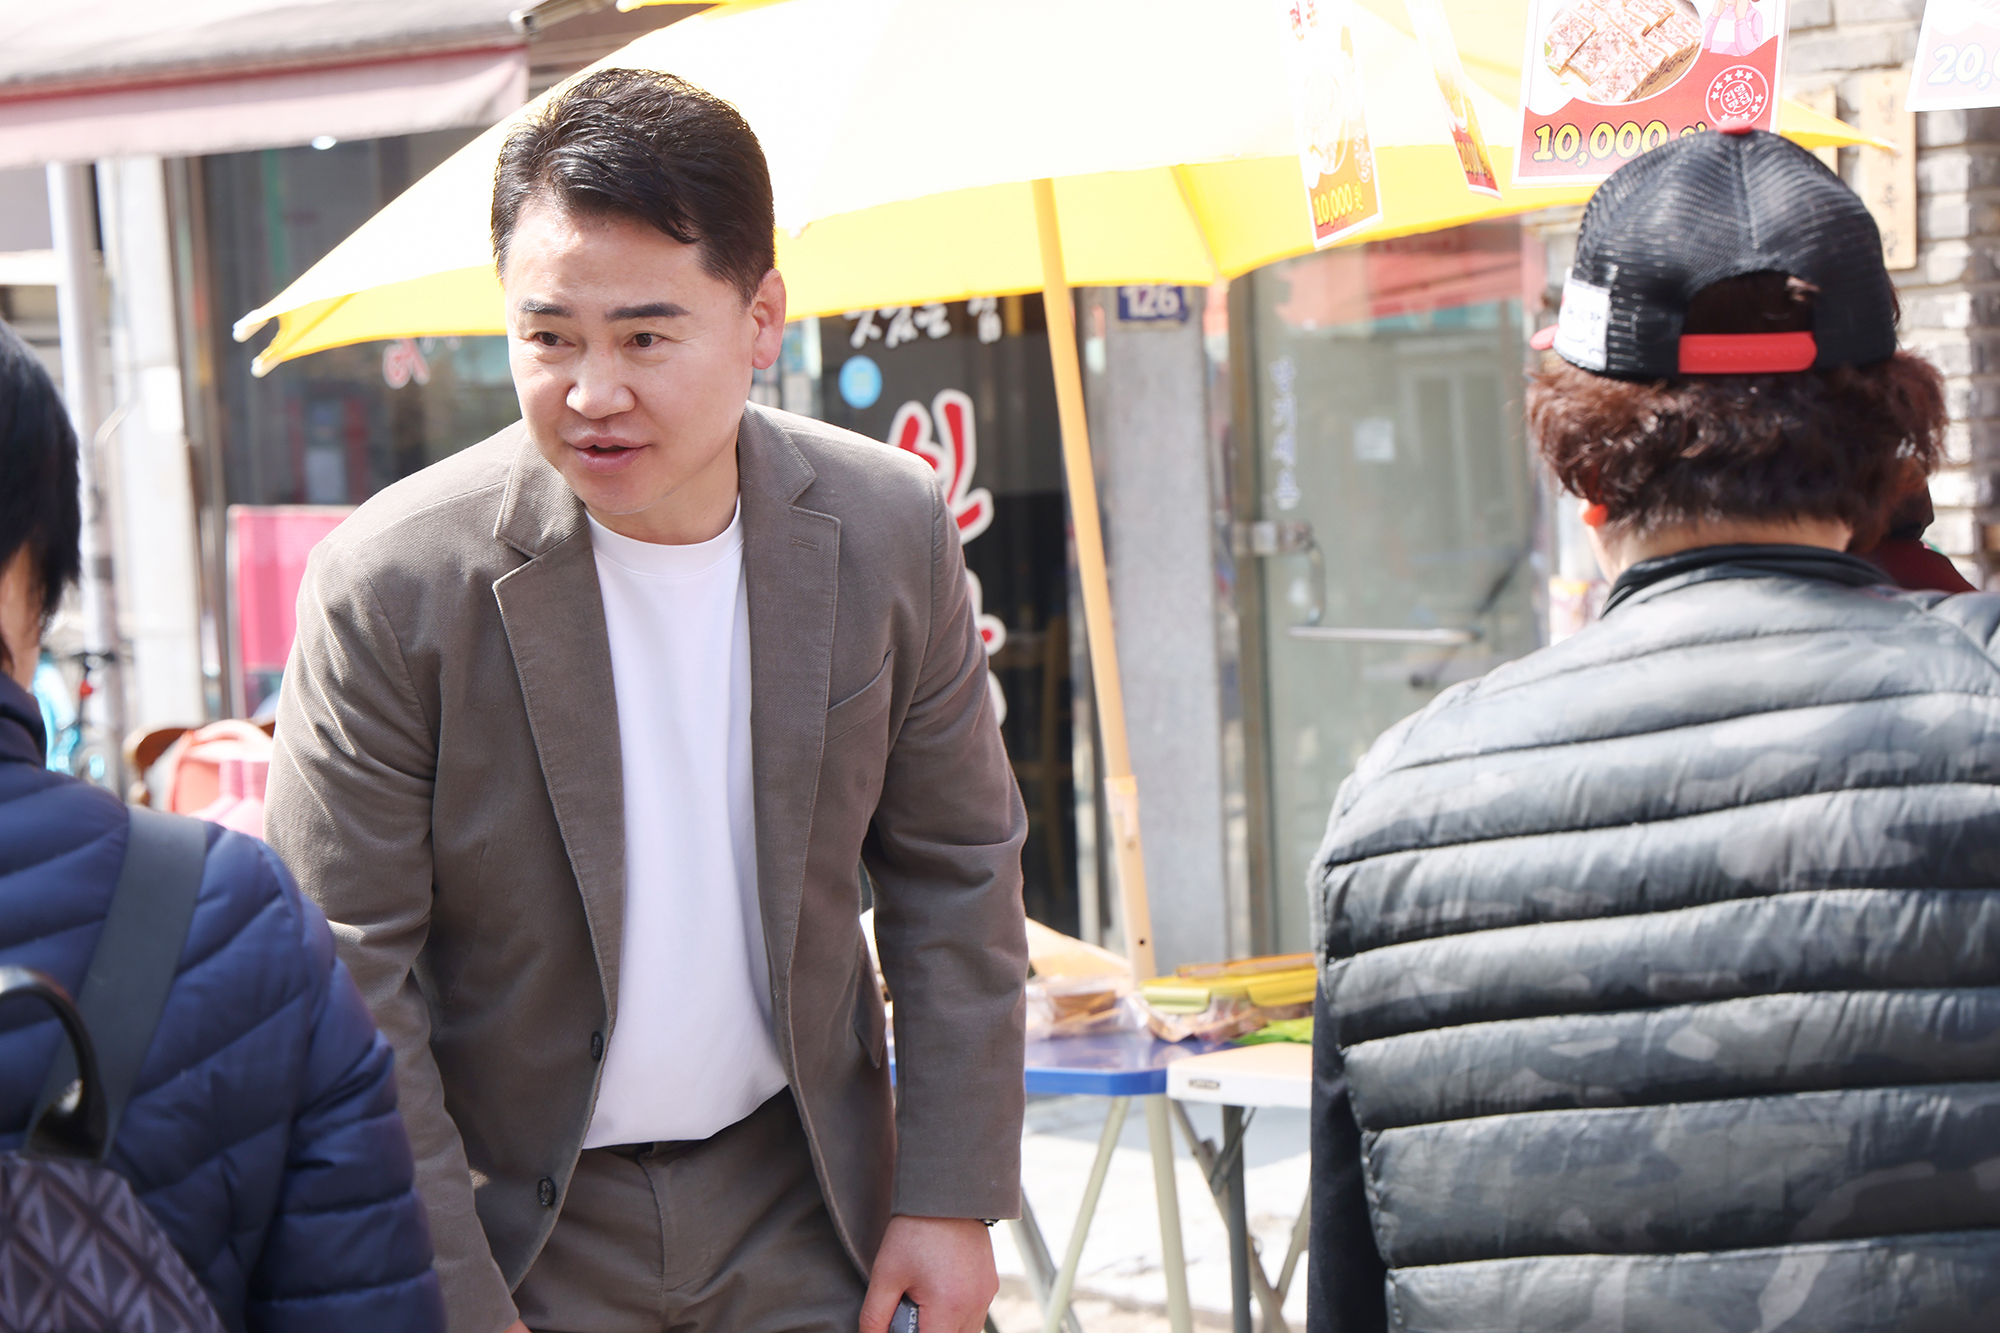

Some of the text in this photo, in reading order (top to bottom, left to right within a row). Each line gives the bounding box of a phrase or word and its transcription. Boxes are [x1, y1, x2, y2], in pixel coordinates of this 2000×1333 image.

[1532, 119, 1670, 168] 10,000
[1313, 182, 1353, 227] 10,000
[1121, 283, 1180, 317] 126
